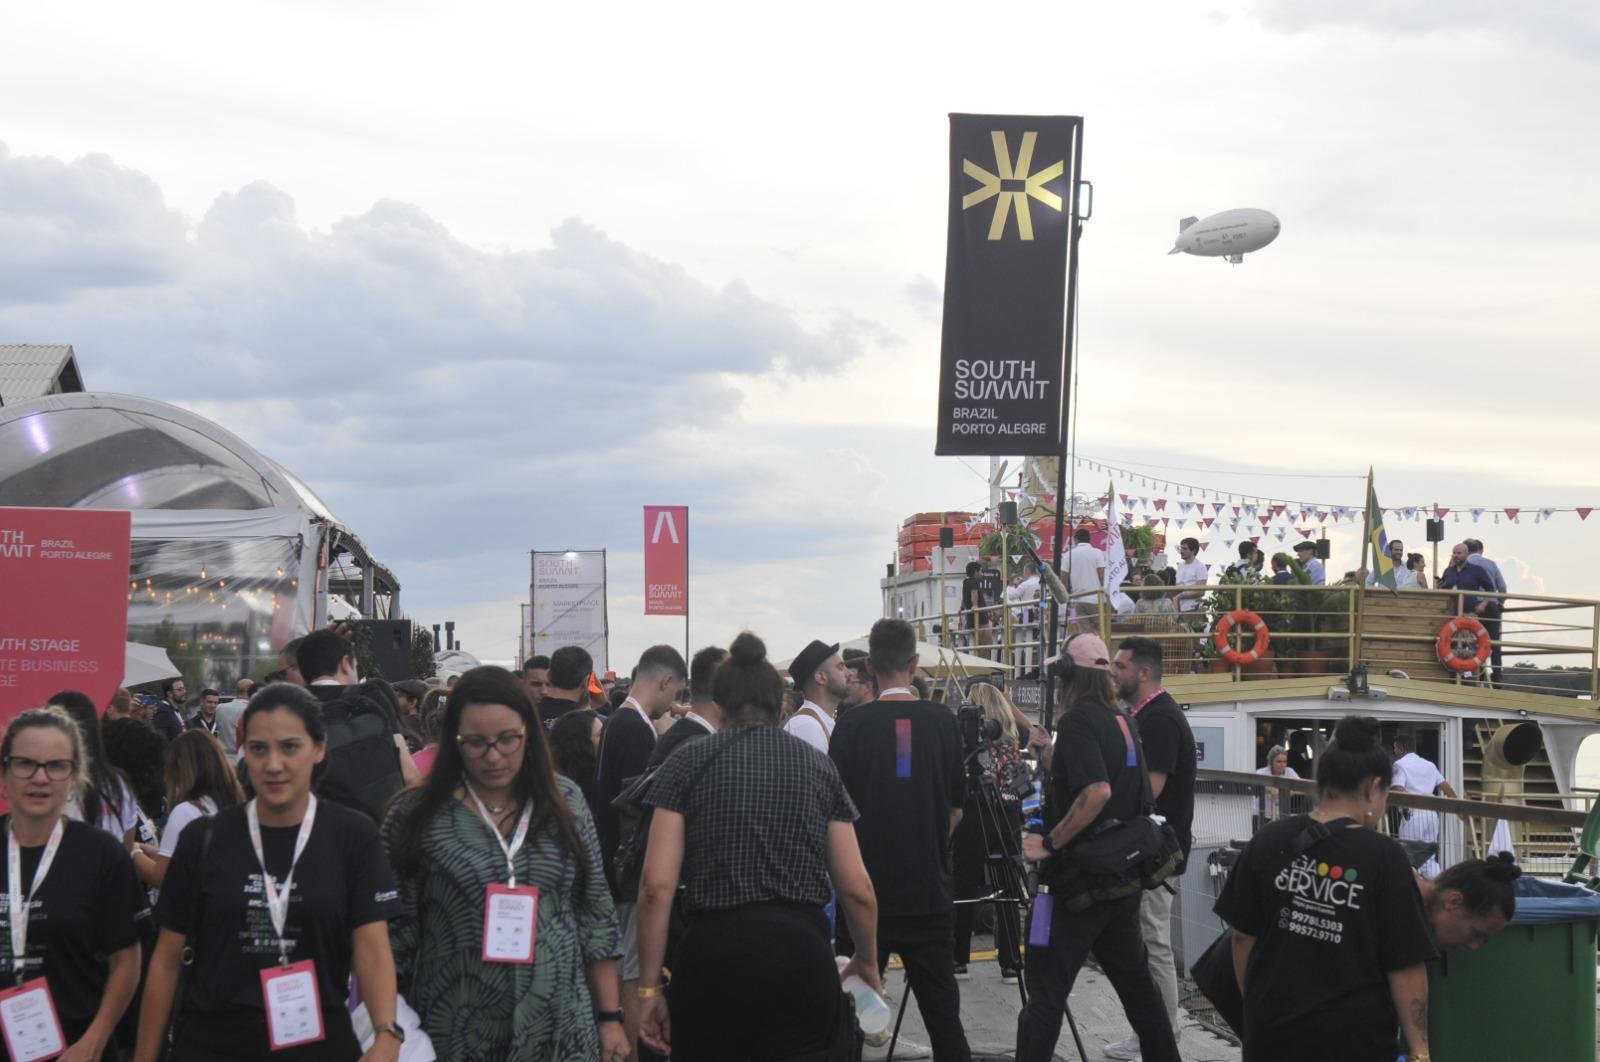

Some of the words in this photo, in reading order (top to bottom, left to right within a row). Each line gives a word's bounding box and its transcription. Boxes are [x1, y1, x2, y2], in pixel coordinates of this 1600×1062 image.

[955, 359, 1036, 379] SOUTH
[954, 379, 1050, 400] SUMMIT
[952, 407, 998, 419] BRAZIL
[951, 423, 995, 435] PORTO
[997, 423, 1046, 435] ALEGRE
[40, 539, 75, 549] BRAZIL
[40, 551, 74, 559] PORTO
[75, 552, 113, 560] ALEGRE
[538, 559, 573, 568] SOUTH
[30, 639, 80, 652] STAGE
[21, 660, 98, 673] BUSINESS
[1275, 868, 1364, 909] SERVICE
